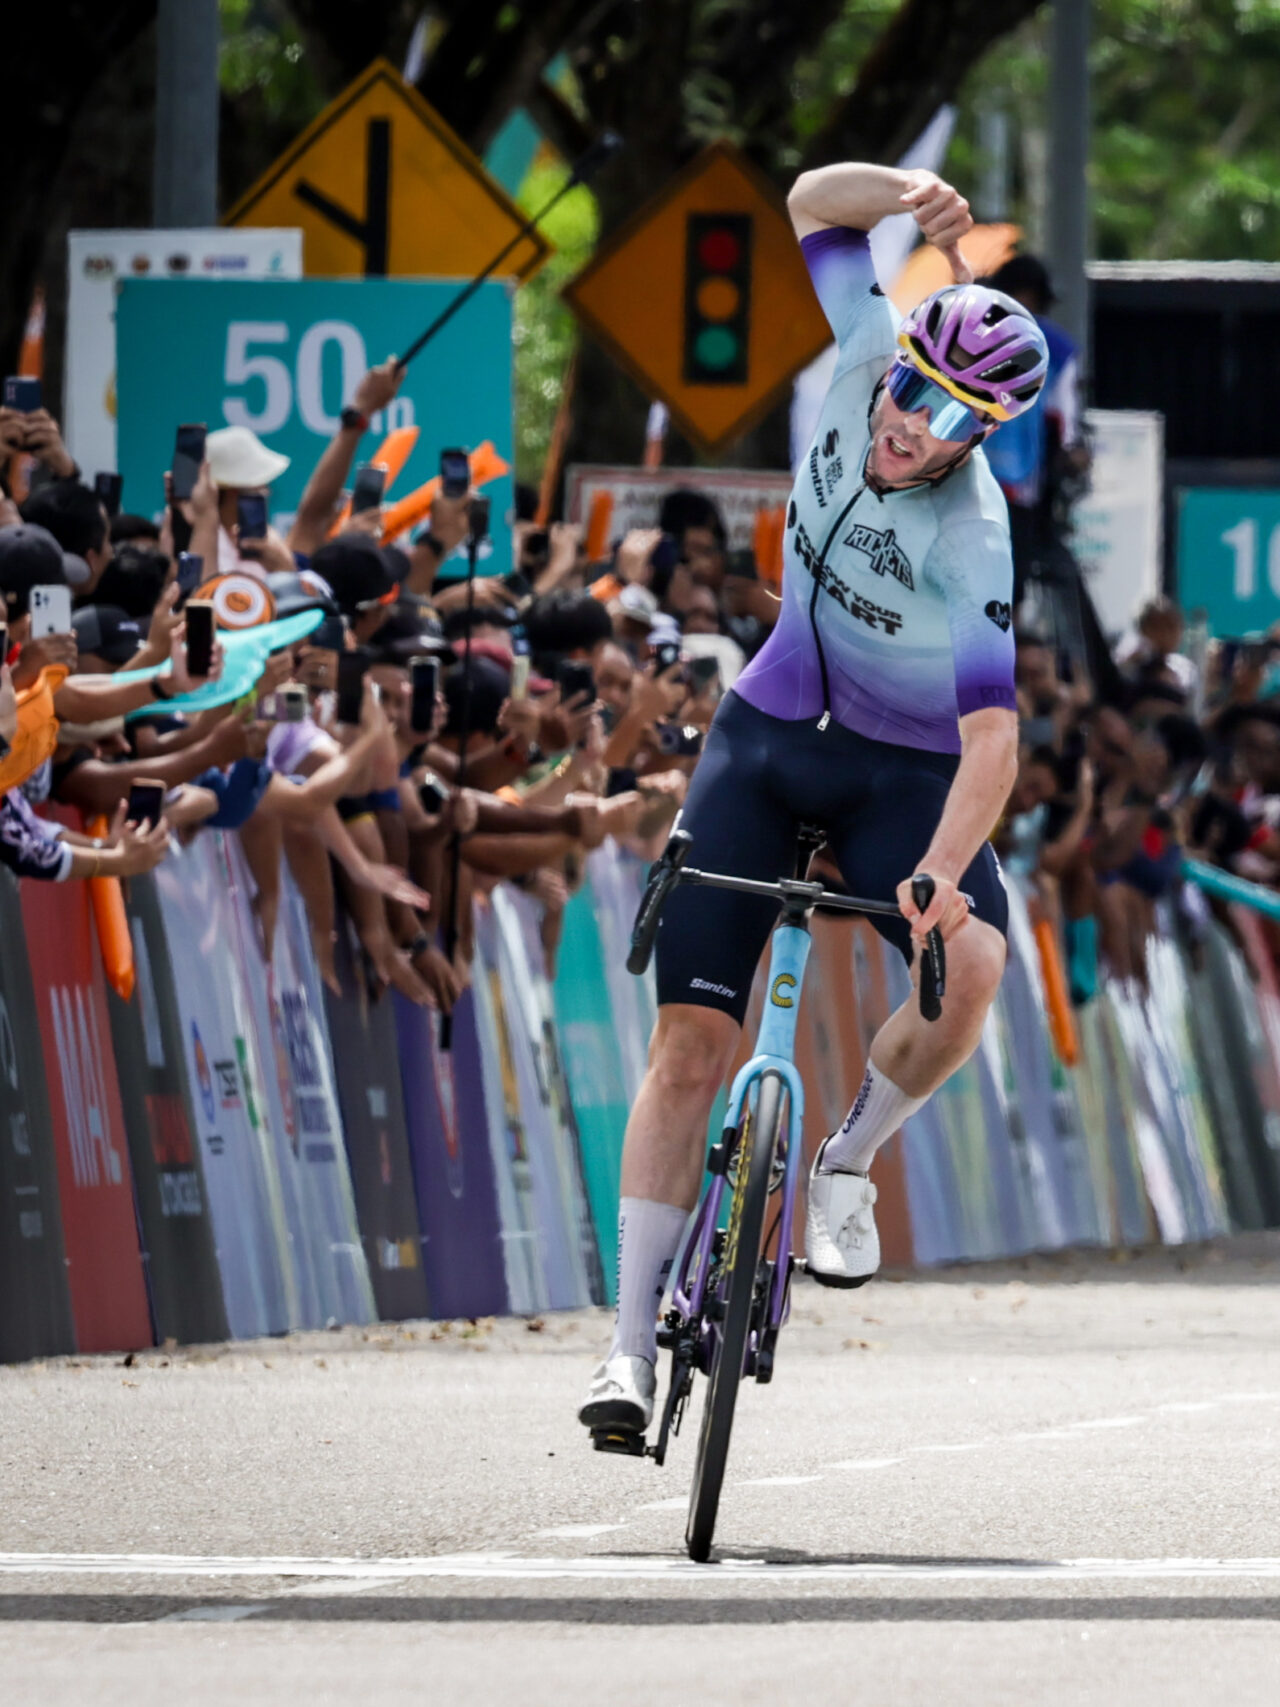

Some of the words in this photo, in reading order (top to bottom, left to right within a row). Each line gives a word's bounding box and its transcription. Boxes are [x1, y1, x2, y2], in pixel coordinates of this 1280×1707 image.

[842, 523, 915, 592] ROCKETS
[852, 591, 903, 621] YOUR
[690, 977, 738, 999] Santini
